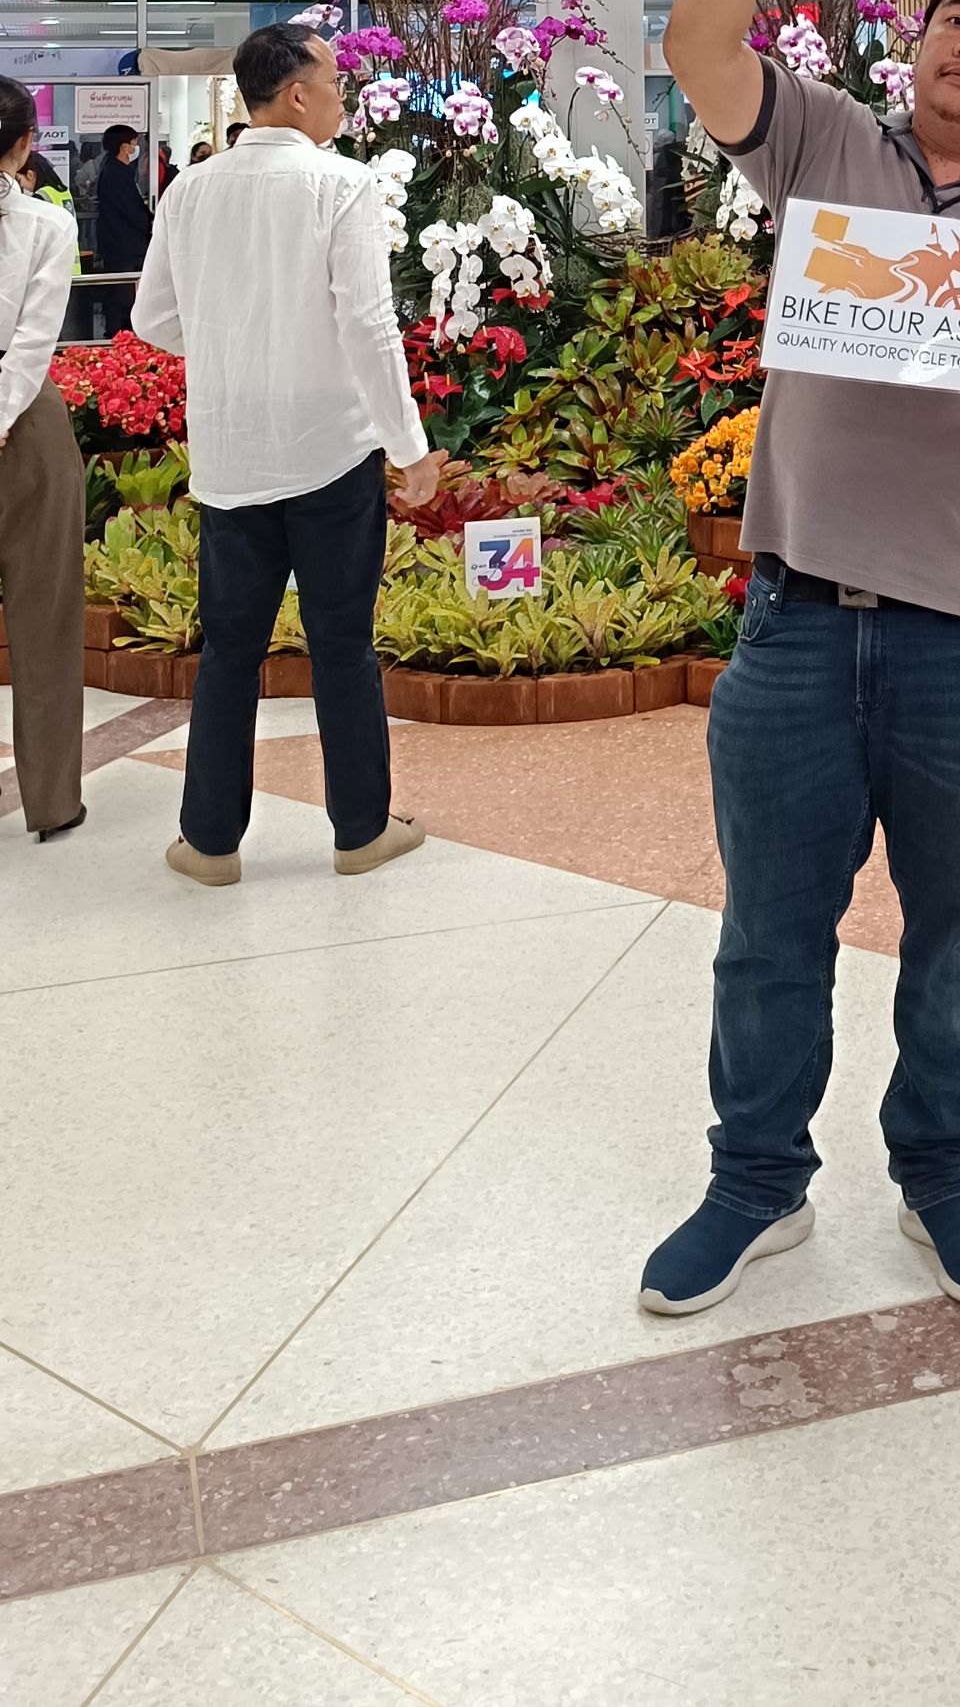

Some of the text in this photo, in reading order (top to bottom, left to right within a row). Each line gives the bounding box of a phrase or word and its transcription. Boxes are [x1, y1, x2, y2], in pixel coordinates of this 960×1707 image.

[781, 295, 841, 327] BIKE
[849, 304, 924, 336] TOUR
[776, 331, 838, 352] QUALITY
[840, 341, 954, 366] MOTORCYCLE
[477, 537, 541, 591] 34
